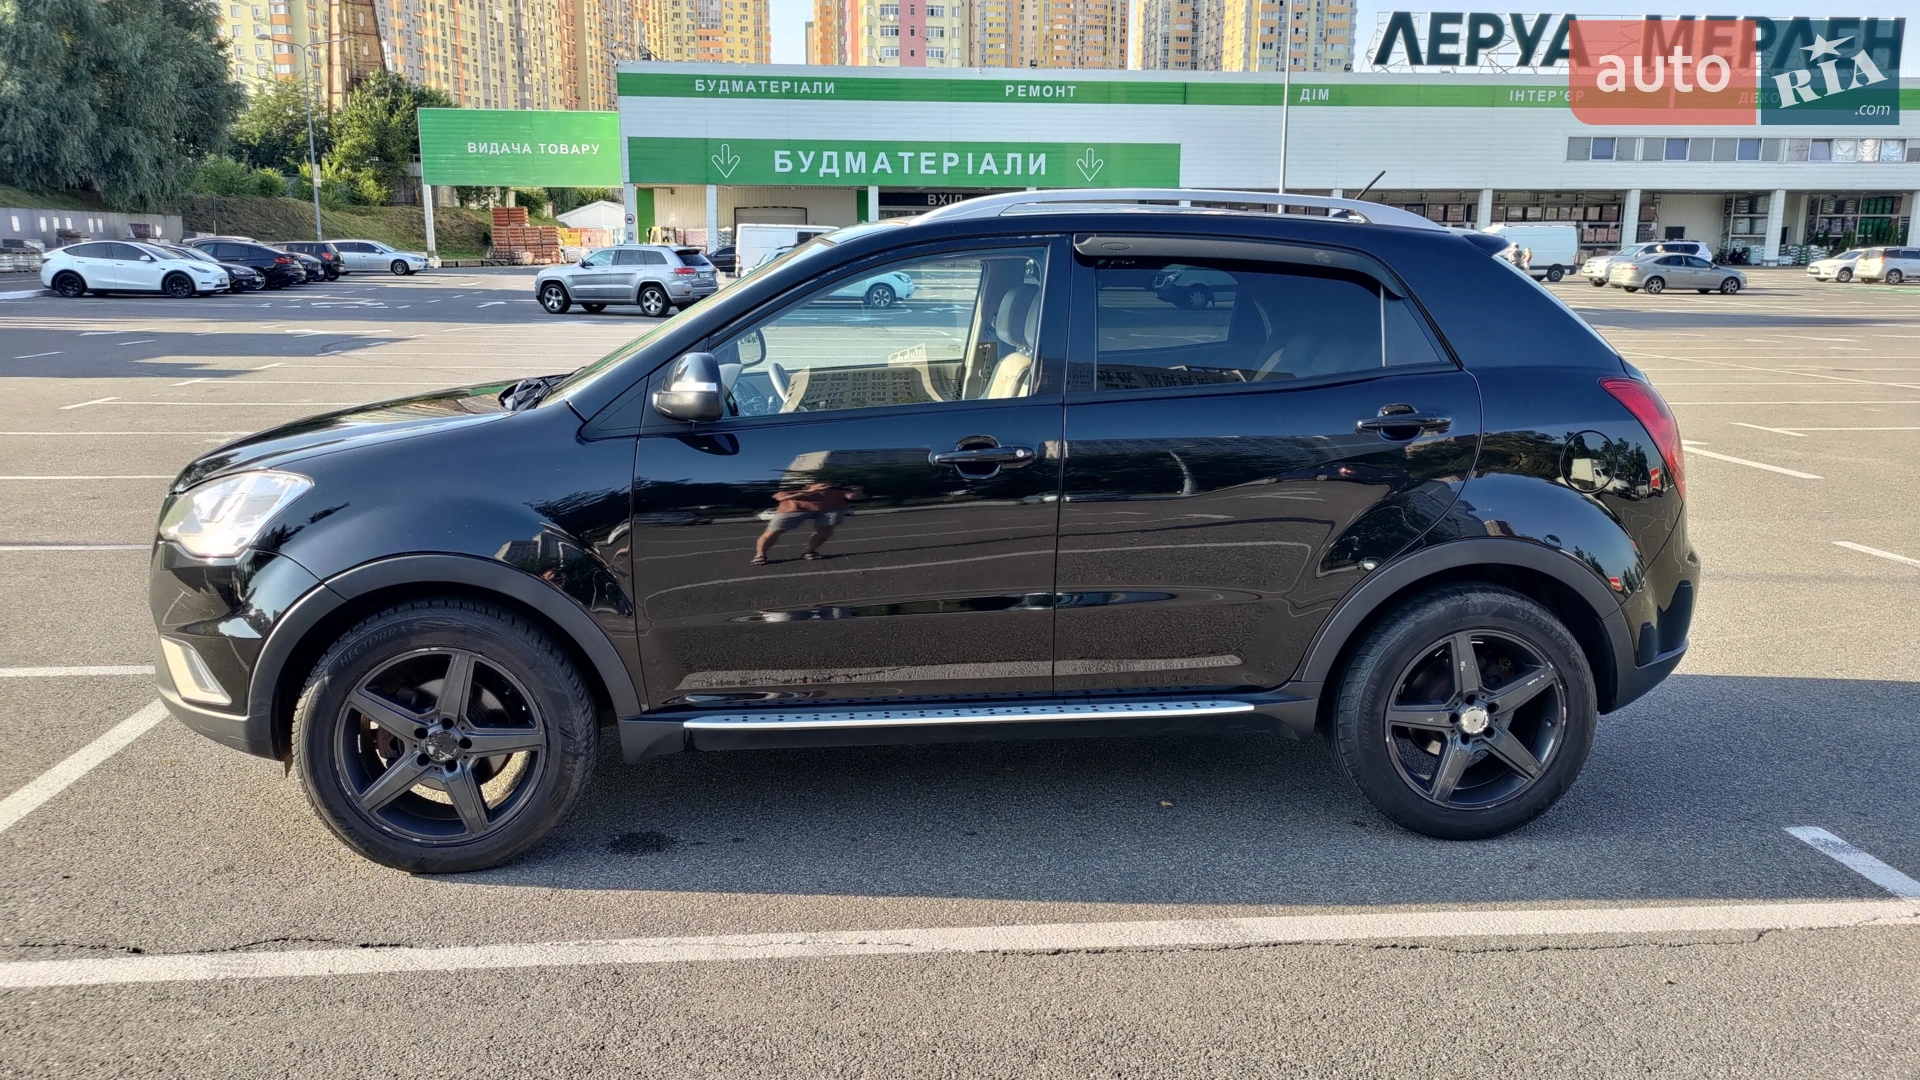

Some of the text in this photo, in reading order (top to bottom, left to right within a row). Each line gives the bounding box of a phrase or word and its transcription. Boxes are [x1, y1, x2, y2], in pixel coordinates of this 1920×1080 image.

[1372, 11, 1592, 66] ЛЕРУА
[695, 79, 835, 94] БУДМАТЕРІАЛИ
[1005, 84, 1077, 98] РЕМОНТ
[1300, 88, 1330, 102] ДІМ
[467, 142, 600, 156] ВИДАЧА ТОВАРУ
[774, 150, 1047, 178] БУДМАТЕРІАЛИ
